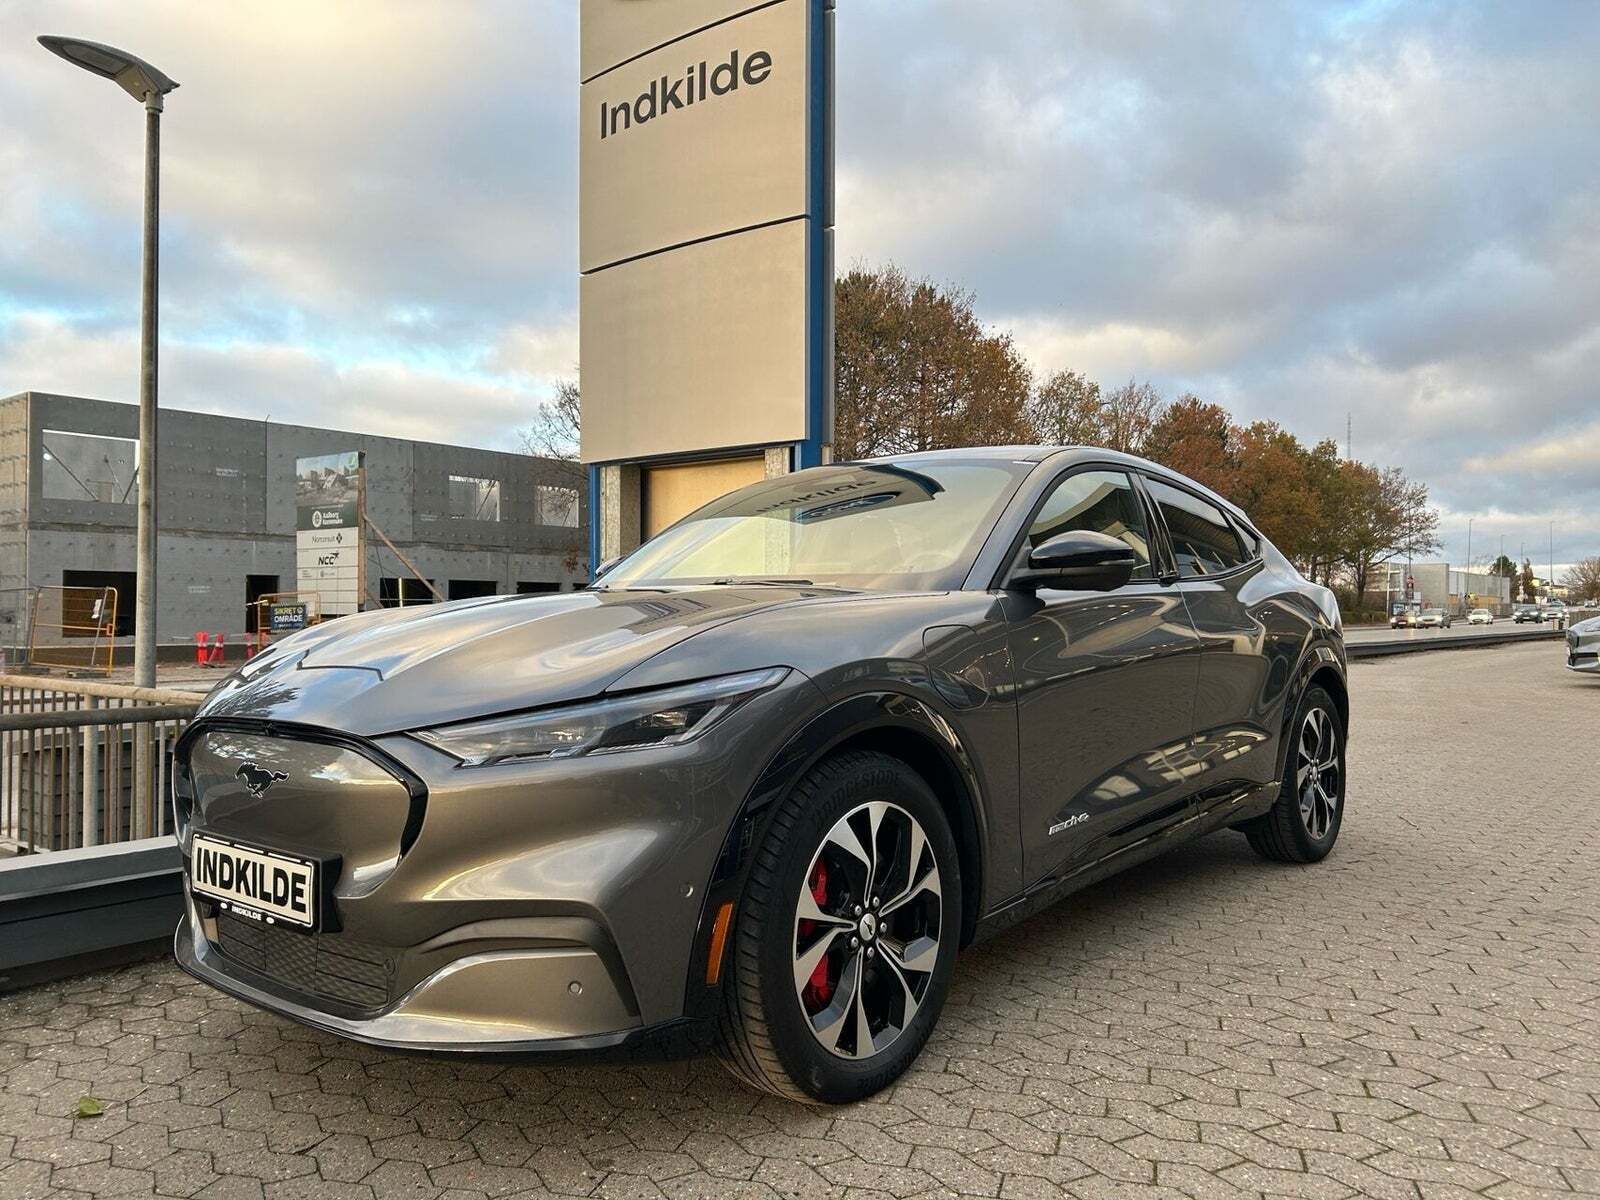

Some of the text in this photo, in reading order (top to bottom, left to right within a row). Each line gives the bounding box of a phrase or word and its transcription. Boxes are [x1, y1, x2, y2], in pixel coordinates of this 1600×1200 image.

[601, 49, 772, 139] Indkilde
[318, 556, 335, 566] NCC
[274, 613, 303, 623] OMRÅDE
[196, 847, 307, 914] INDKILDE
[231, 905, 262, 921] INDKILDE
